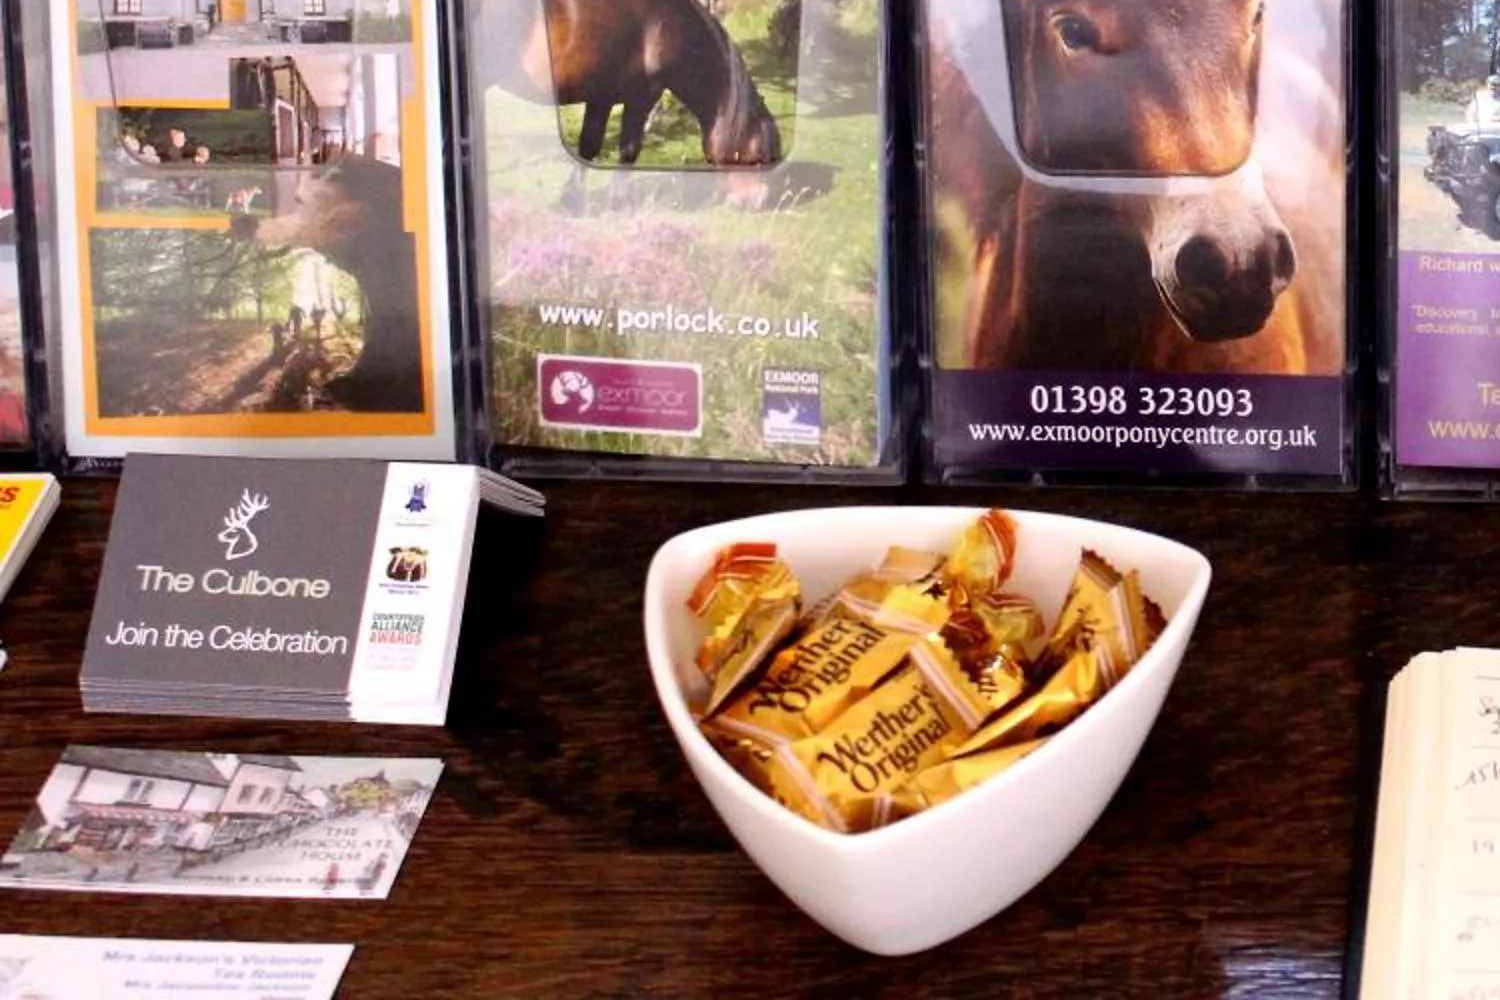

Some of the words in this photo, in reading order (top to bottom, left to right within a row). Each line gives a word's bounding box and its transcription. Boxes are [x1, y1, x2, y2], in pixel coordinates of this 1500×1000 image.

[1420, 257, 1483, 273] Richard
[765, 370, 818, 385] EXMOOR
[1030, 386, 1127, 414] 01398
[1138, 387, 1254, 416] 323093
[968, 420, 1317, 450] www.exmoorponycentre.org.uk
[136, 565, 195, 593] The
[201, 568, 330, 598] Culbone
[105, 621, 158, 647] Join
[163, 624, 204, 649] the
[209, 626, 348, 655] Celebration
[778, 622, 888, 713] Original
[850, 702, 952, 793] Original
